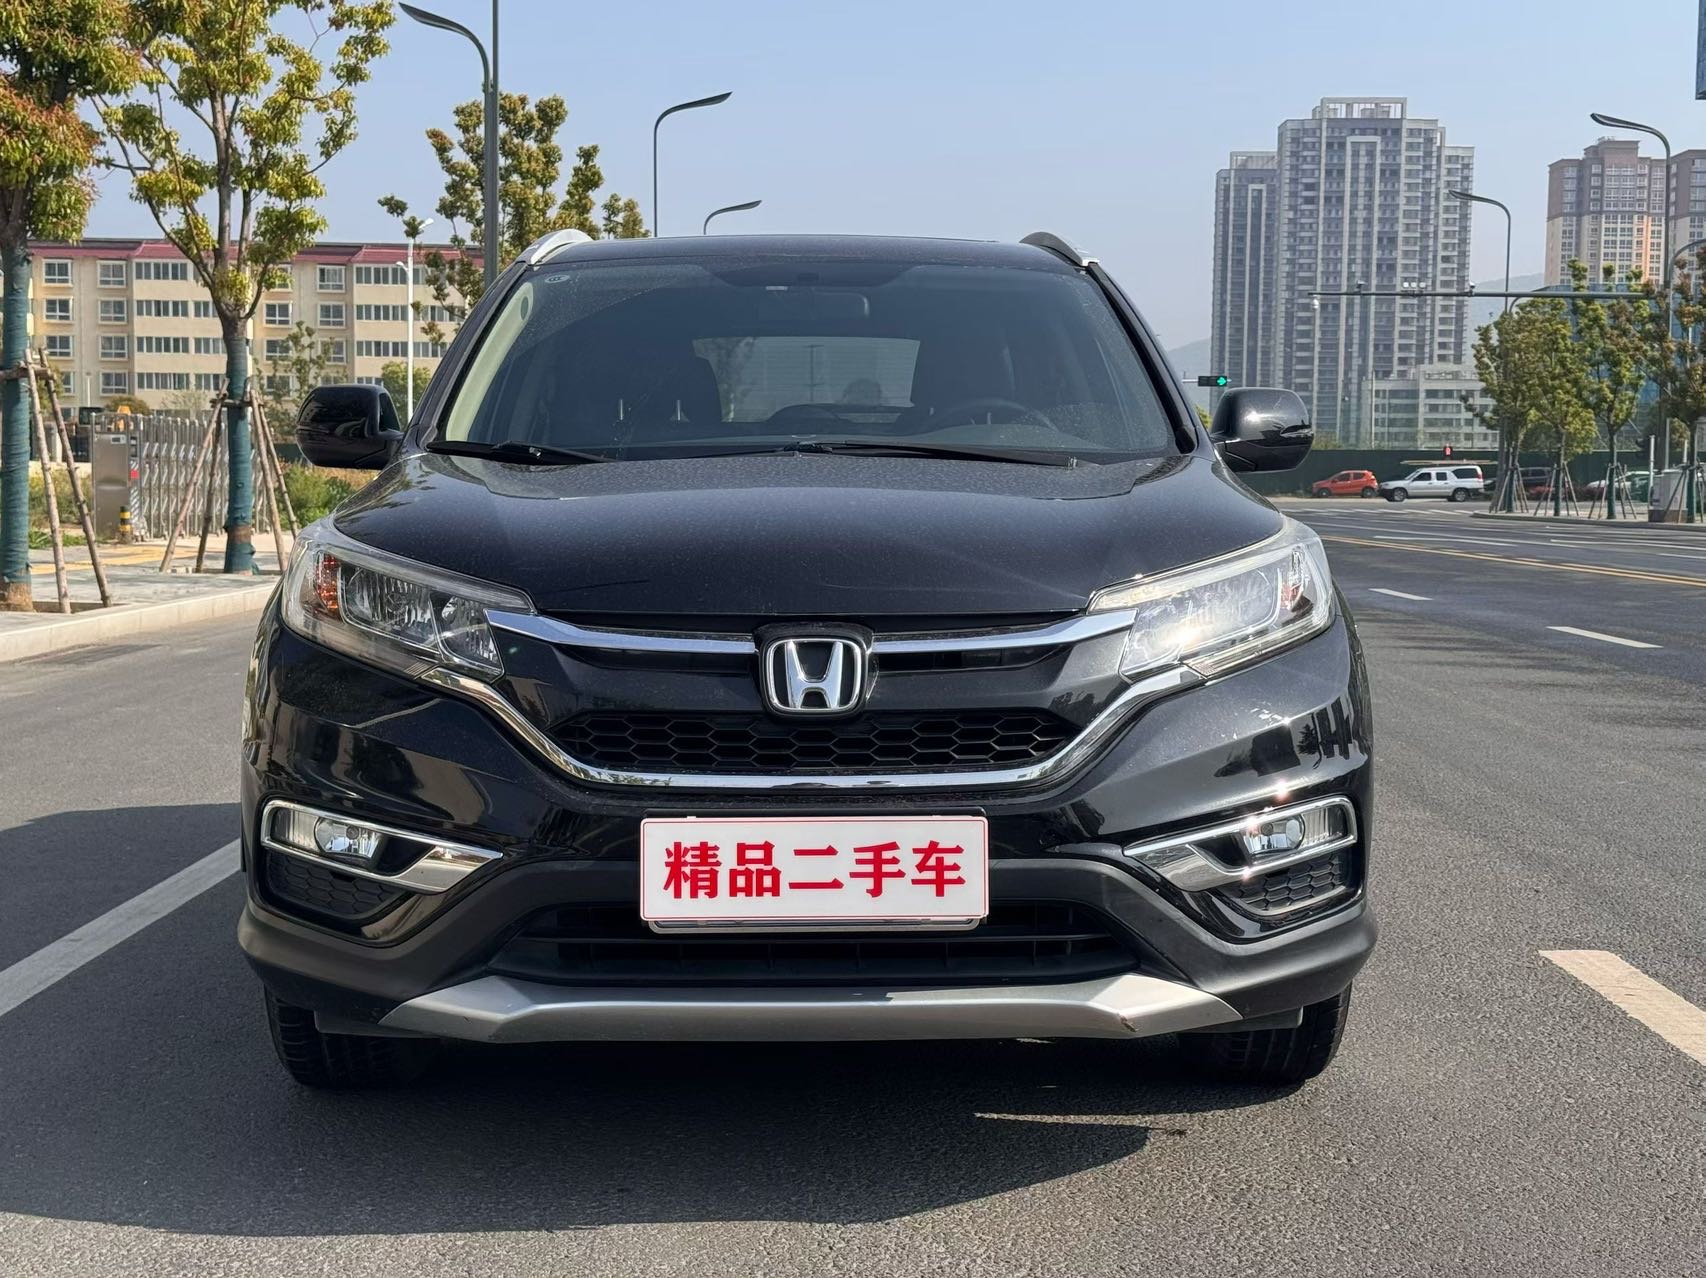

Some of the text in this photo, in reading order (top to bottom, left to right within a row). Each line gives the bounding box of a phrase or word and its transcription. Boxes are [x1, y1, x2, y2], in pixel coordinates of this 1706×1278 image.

[663, 840, 966, 899] 精品二手车
